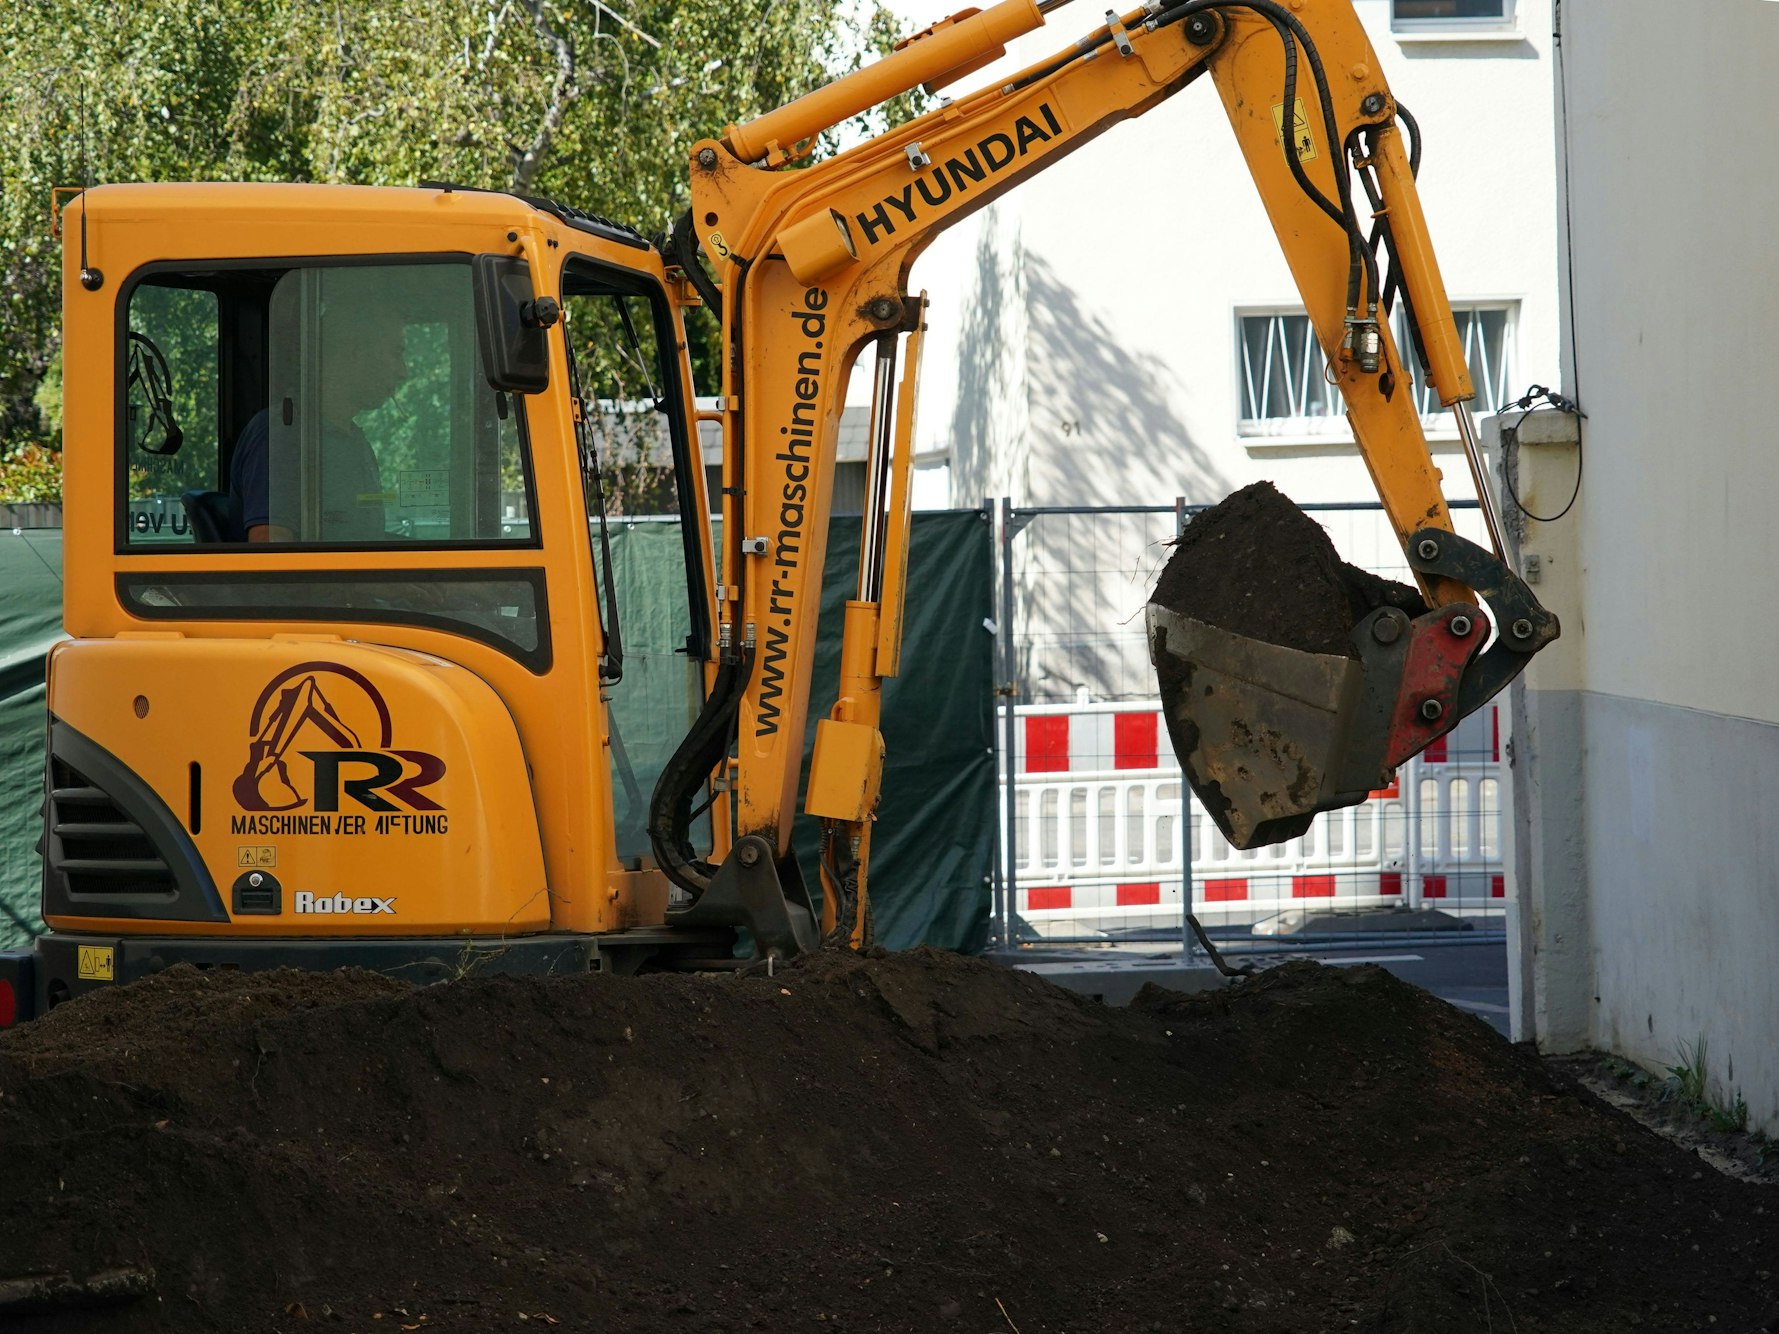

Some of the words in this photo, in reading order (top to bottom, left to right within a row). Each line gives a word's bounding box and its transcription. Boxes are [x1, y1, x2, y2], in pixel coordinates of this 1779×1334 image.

[856, 102, 1063, 245] HYUNDAI
[1061, 421, 1080, 437] 91
[755, 286, 829, 738] www.rr-maschinen.de
[295, 891, 397, 914] Robex
